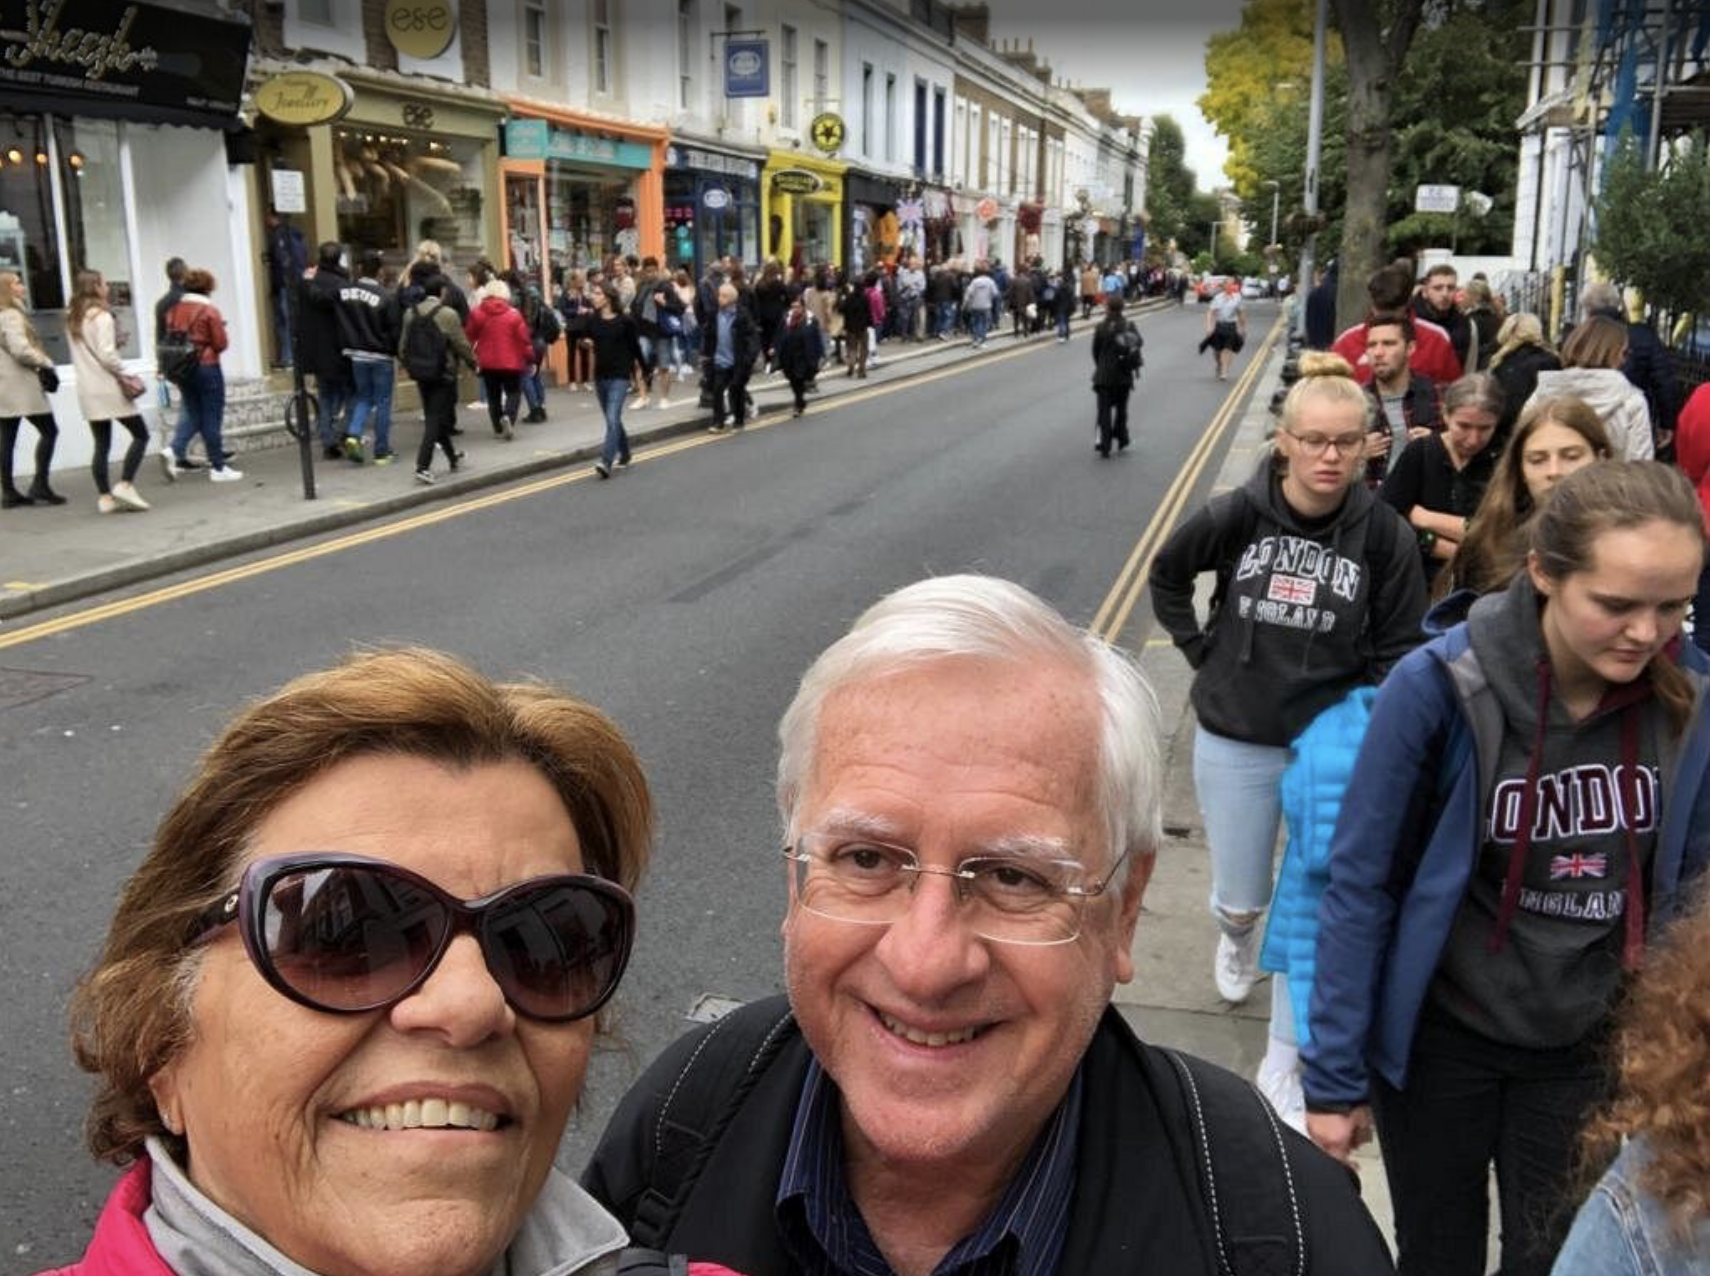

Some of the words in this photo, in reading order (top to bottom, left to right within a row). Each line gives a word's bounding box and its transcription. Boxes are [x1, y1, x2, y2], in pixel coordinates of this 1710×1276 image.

[392, 7, 447, 31] ese
[1237, 536, 1361, 602] LONDON
[1485, 764, 1661, 843] ONDO
[1501, 878, 1628, 919] NGLAN
